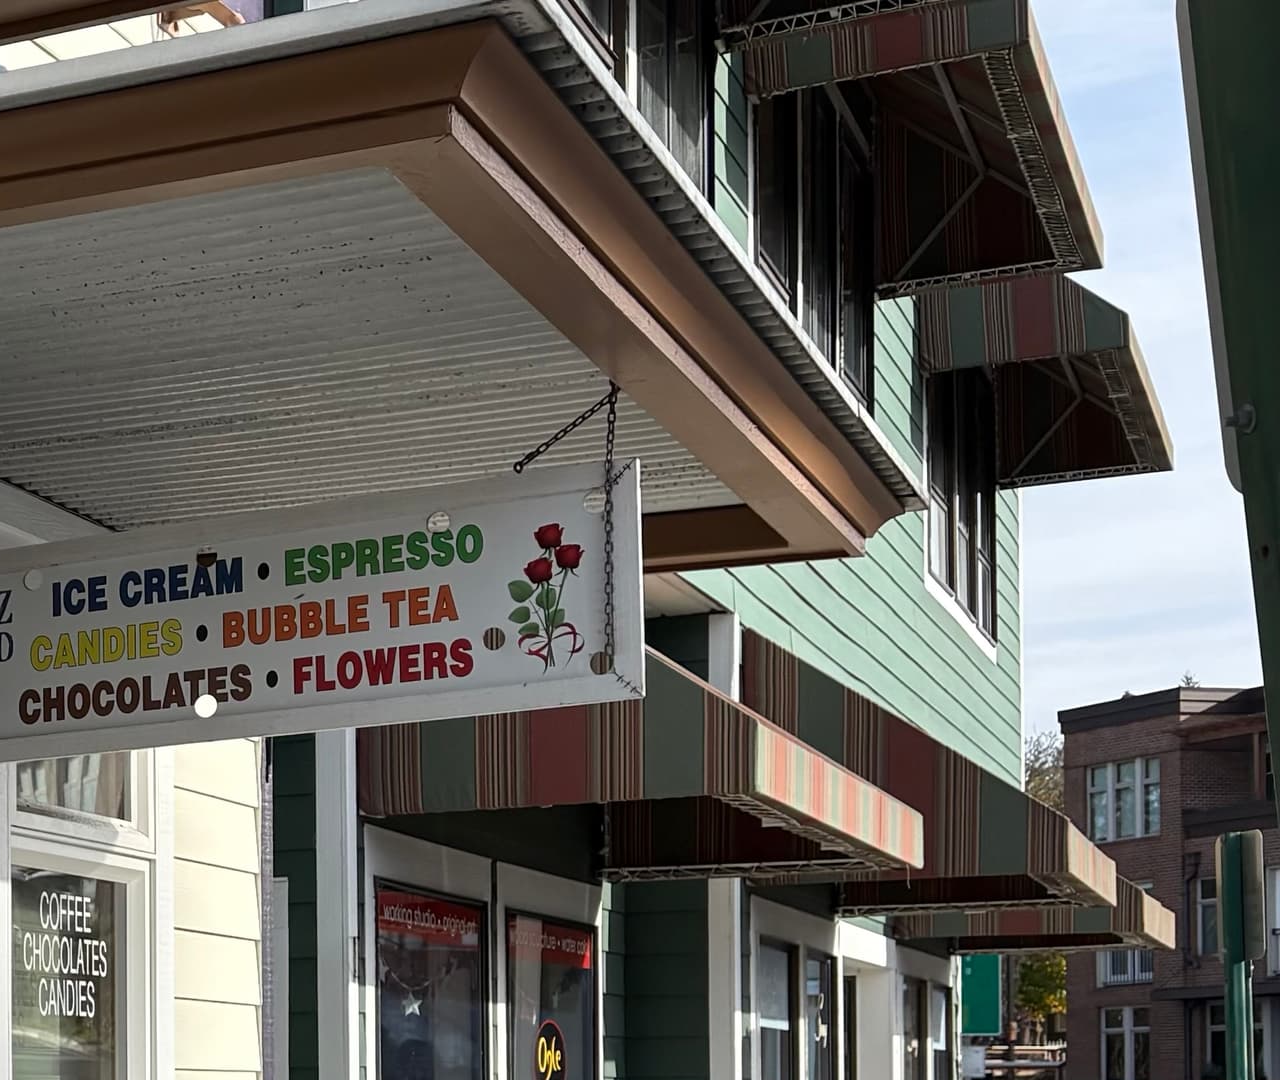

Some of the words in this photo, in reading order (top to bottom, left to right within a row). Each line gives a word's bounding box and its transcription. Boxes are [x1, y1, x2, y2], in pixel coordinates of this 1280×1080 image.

[52, 576, 107, 617] ICE
[119, 557, 243, 607] CREAM
[284, 524, 483, 586] ESPRESSO
[30, 618, 183, 671] CANDIES
[222, 594, 370, 648] BUBBLE
[382, 584, 459, 628] TEA
[19, 664, 252, 725] CHOCOLATES
[293, 638, 474, 694] FLOWERS
[40, 891, 92, 933] COFFEE
[383, 903, 412, 929] working
[414, 905, 437, 929] studio
[23, 932, 108, 977] CHOCOLATES
[38, 978, 96, 1018] CANDIES
